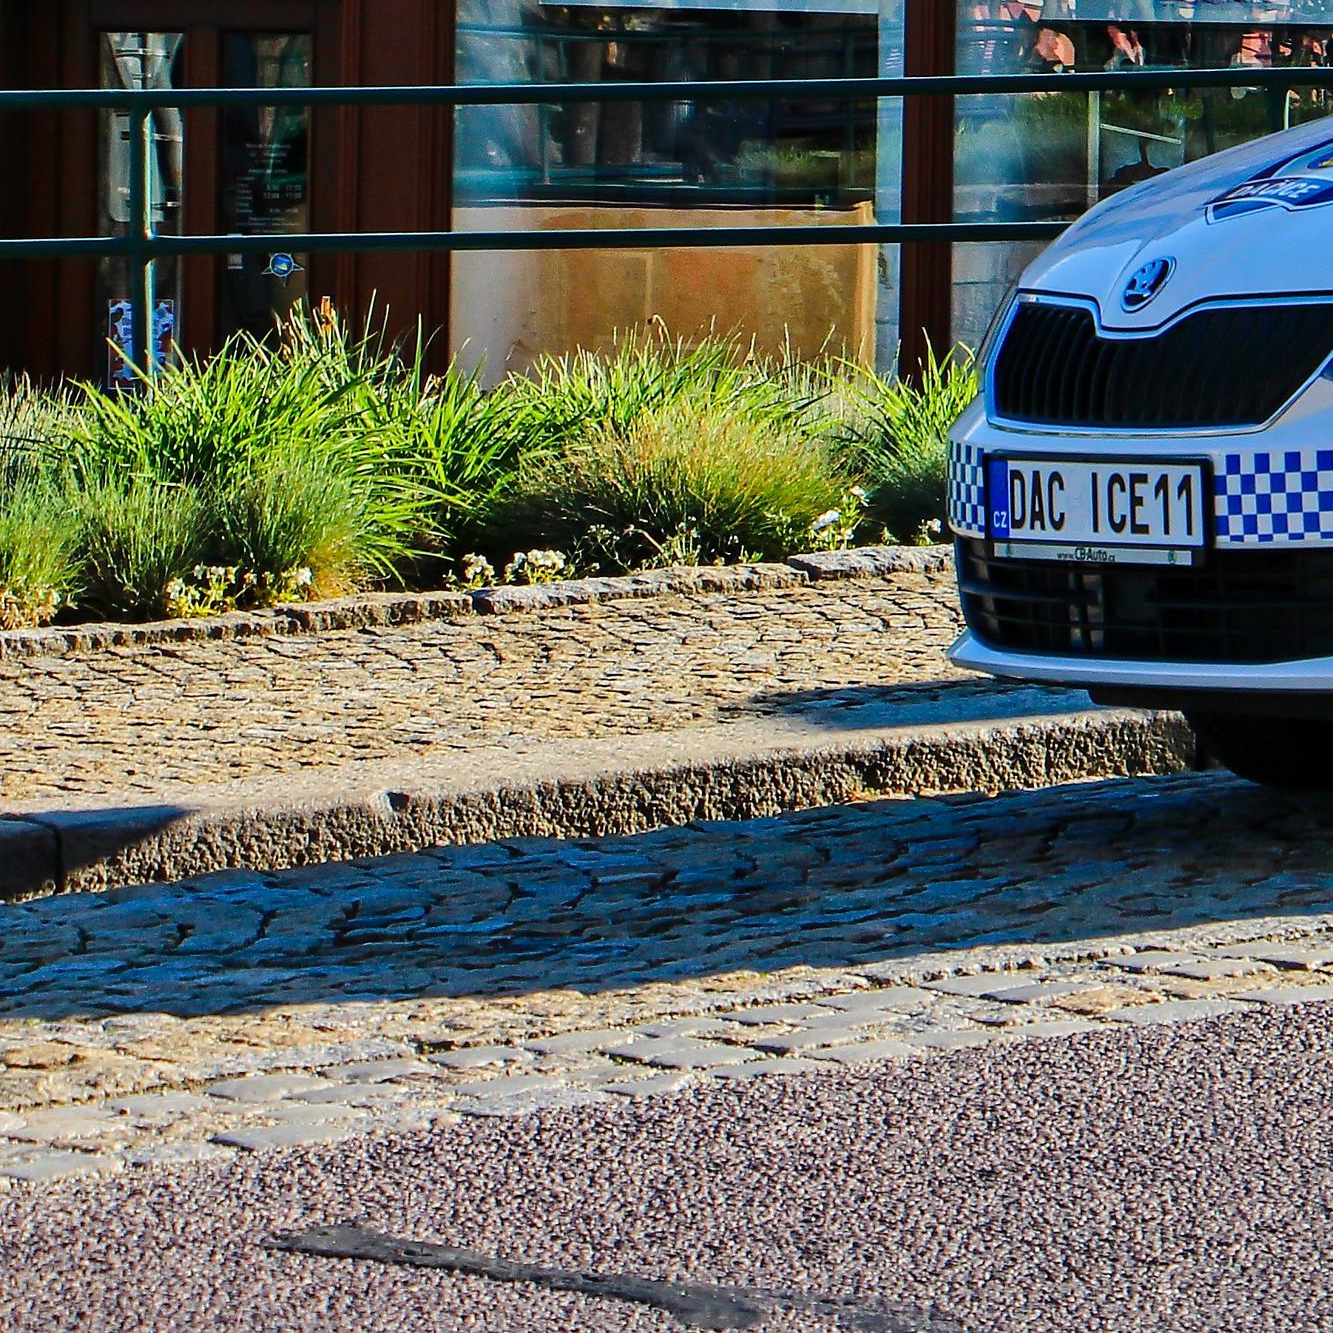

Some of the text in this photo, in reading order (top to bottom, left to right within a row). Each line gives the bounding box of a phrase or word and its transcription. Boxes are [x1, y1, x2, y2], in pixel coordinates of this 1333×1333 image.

[993, 470, 1193, 536] CZ DAC ICE11
